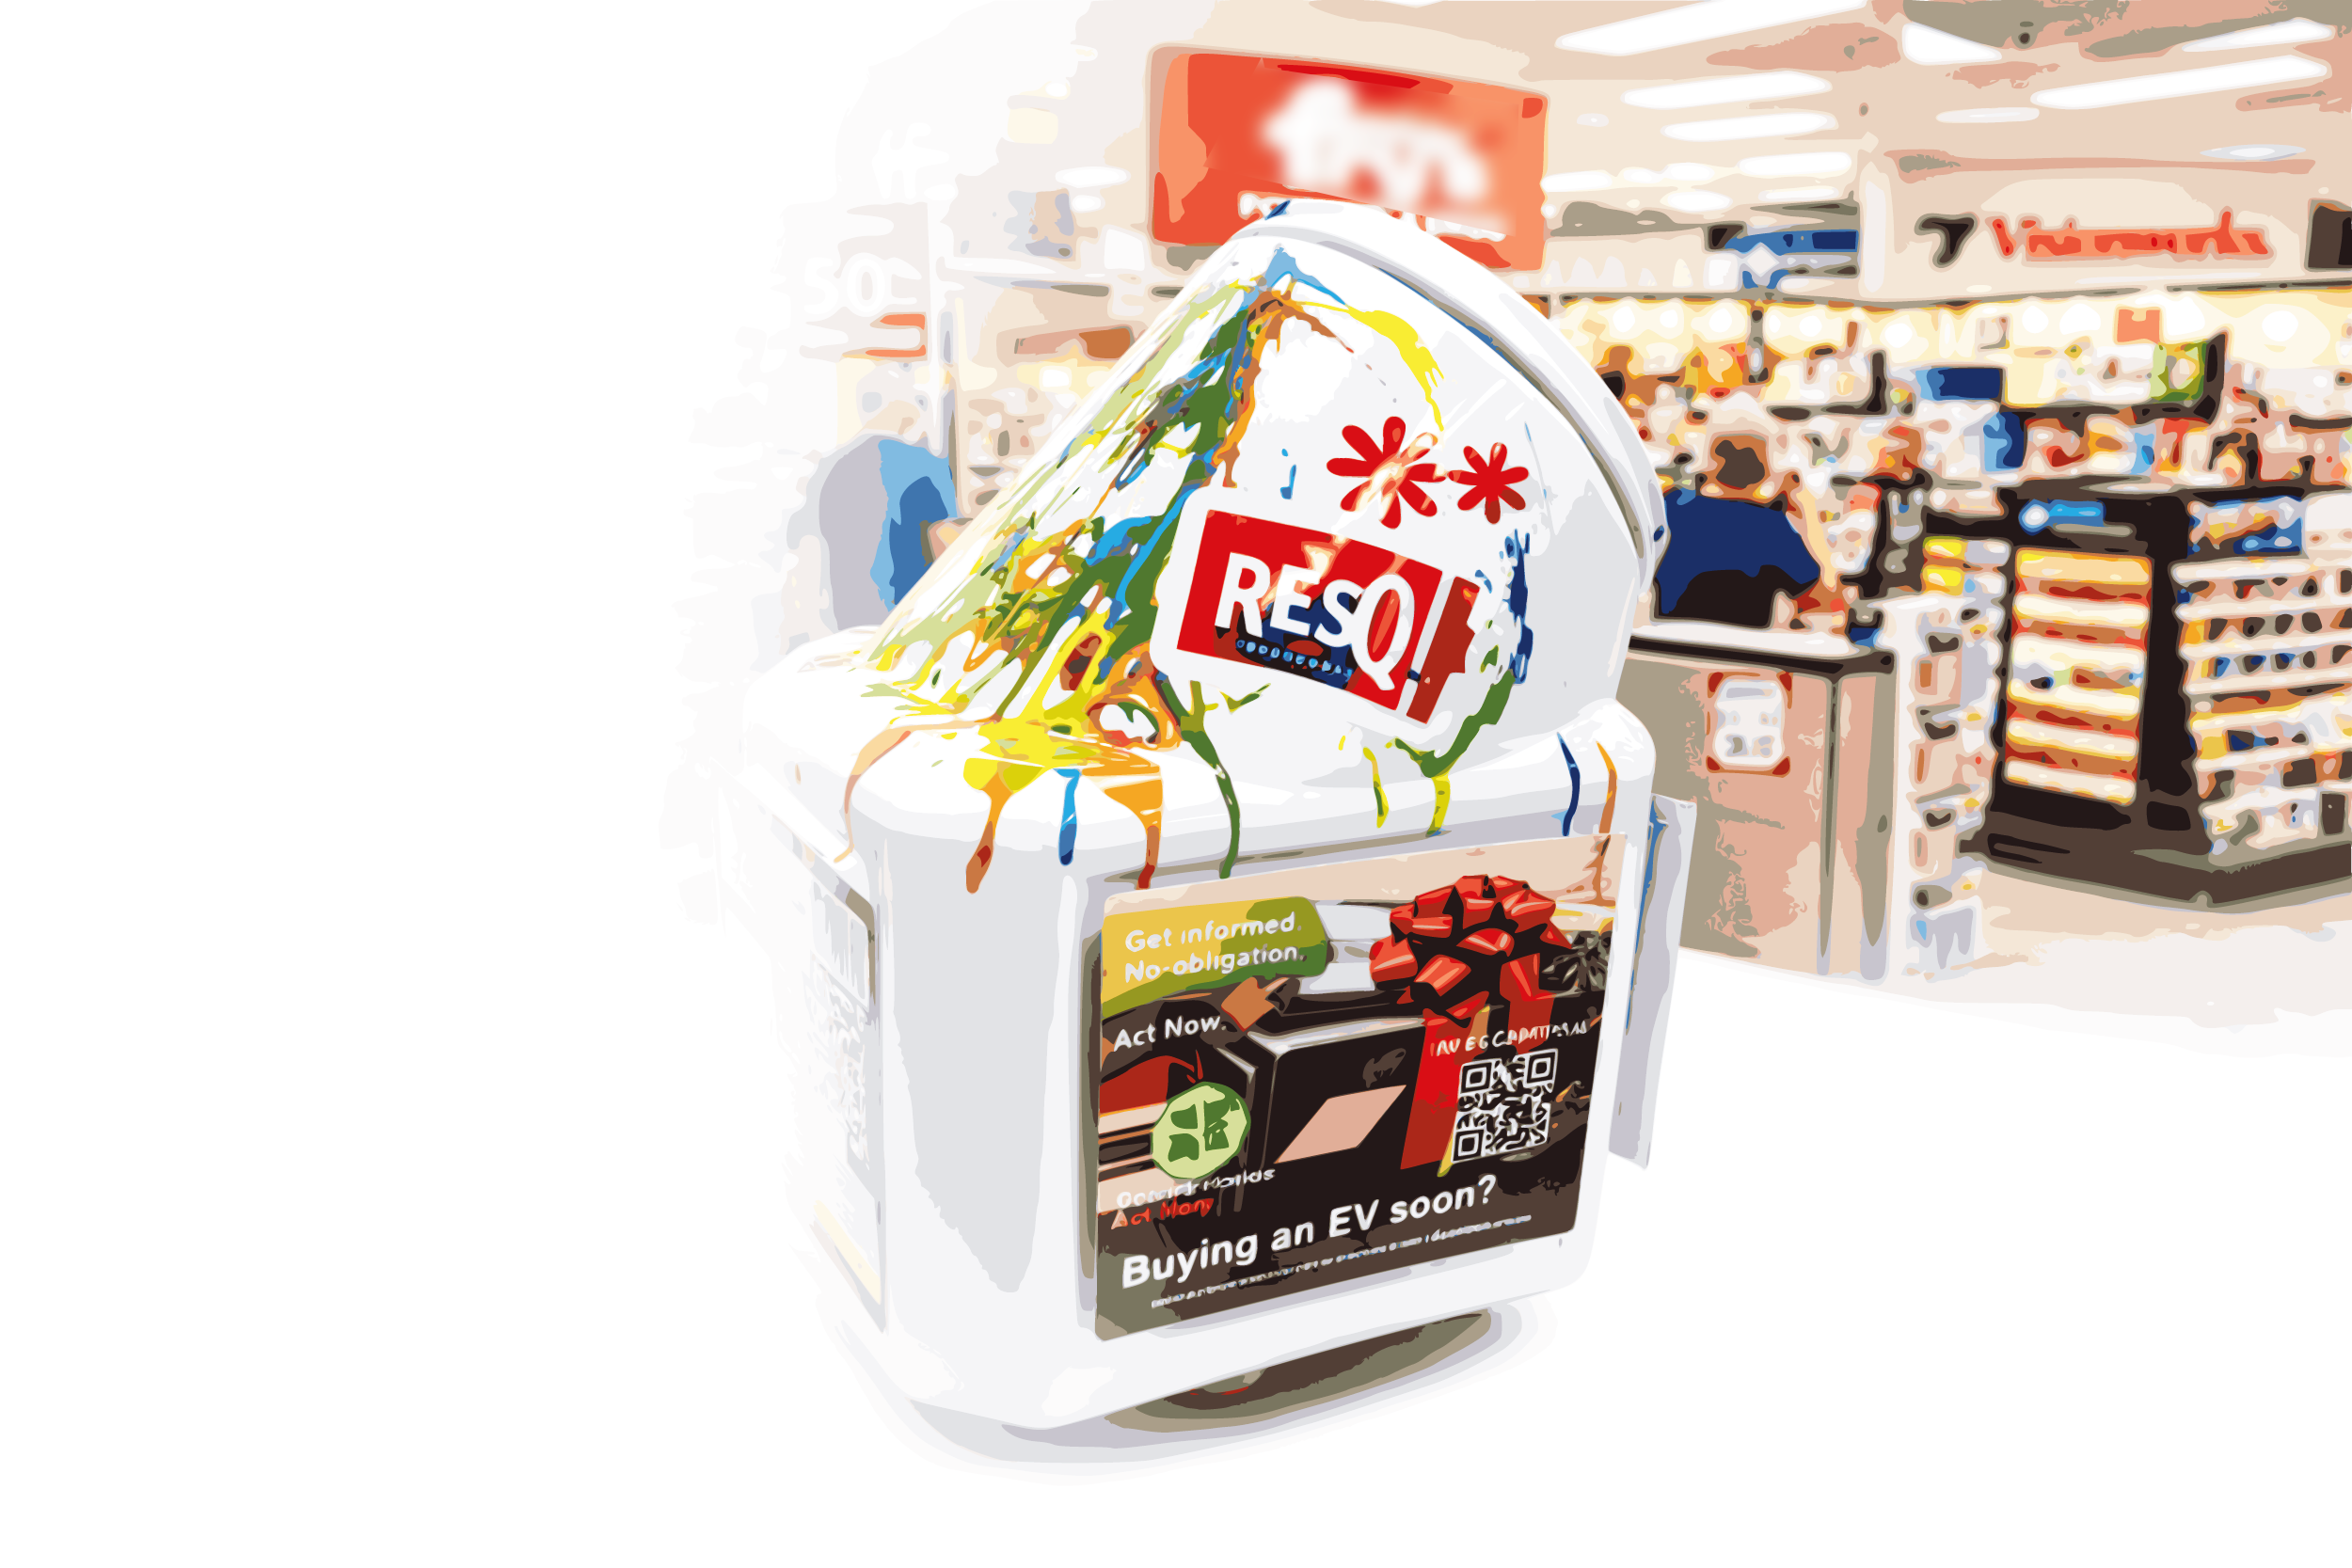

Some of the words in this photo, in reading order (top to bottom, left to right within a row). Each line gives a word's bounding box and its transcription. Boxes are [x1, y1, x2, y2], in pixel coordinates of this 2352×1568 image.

[1215, 551, 1416, 691] RESQ
[1125, 928, 1172, 953] Get
[1181, 911, 1303, 945] informed.
[1124, 943, 1308, 984] No-obligation.
[1113, 1022, 1156, 1053] Act
[1165, 1015, 1227, 1039] Now.
[1121, 1233, 1259, 1290] Buying
[1270, 1221, 1314, 1252] an
[1328, 1198, 1380, 1238] EV
[1389, 1173, 1498, 1225] soon?
